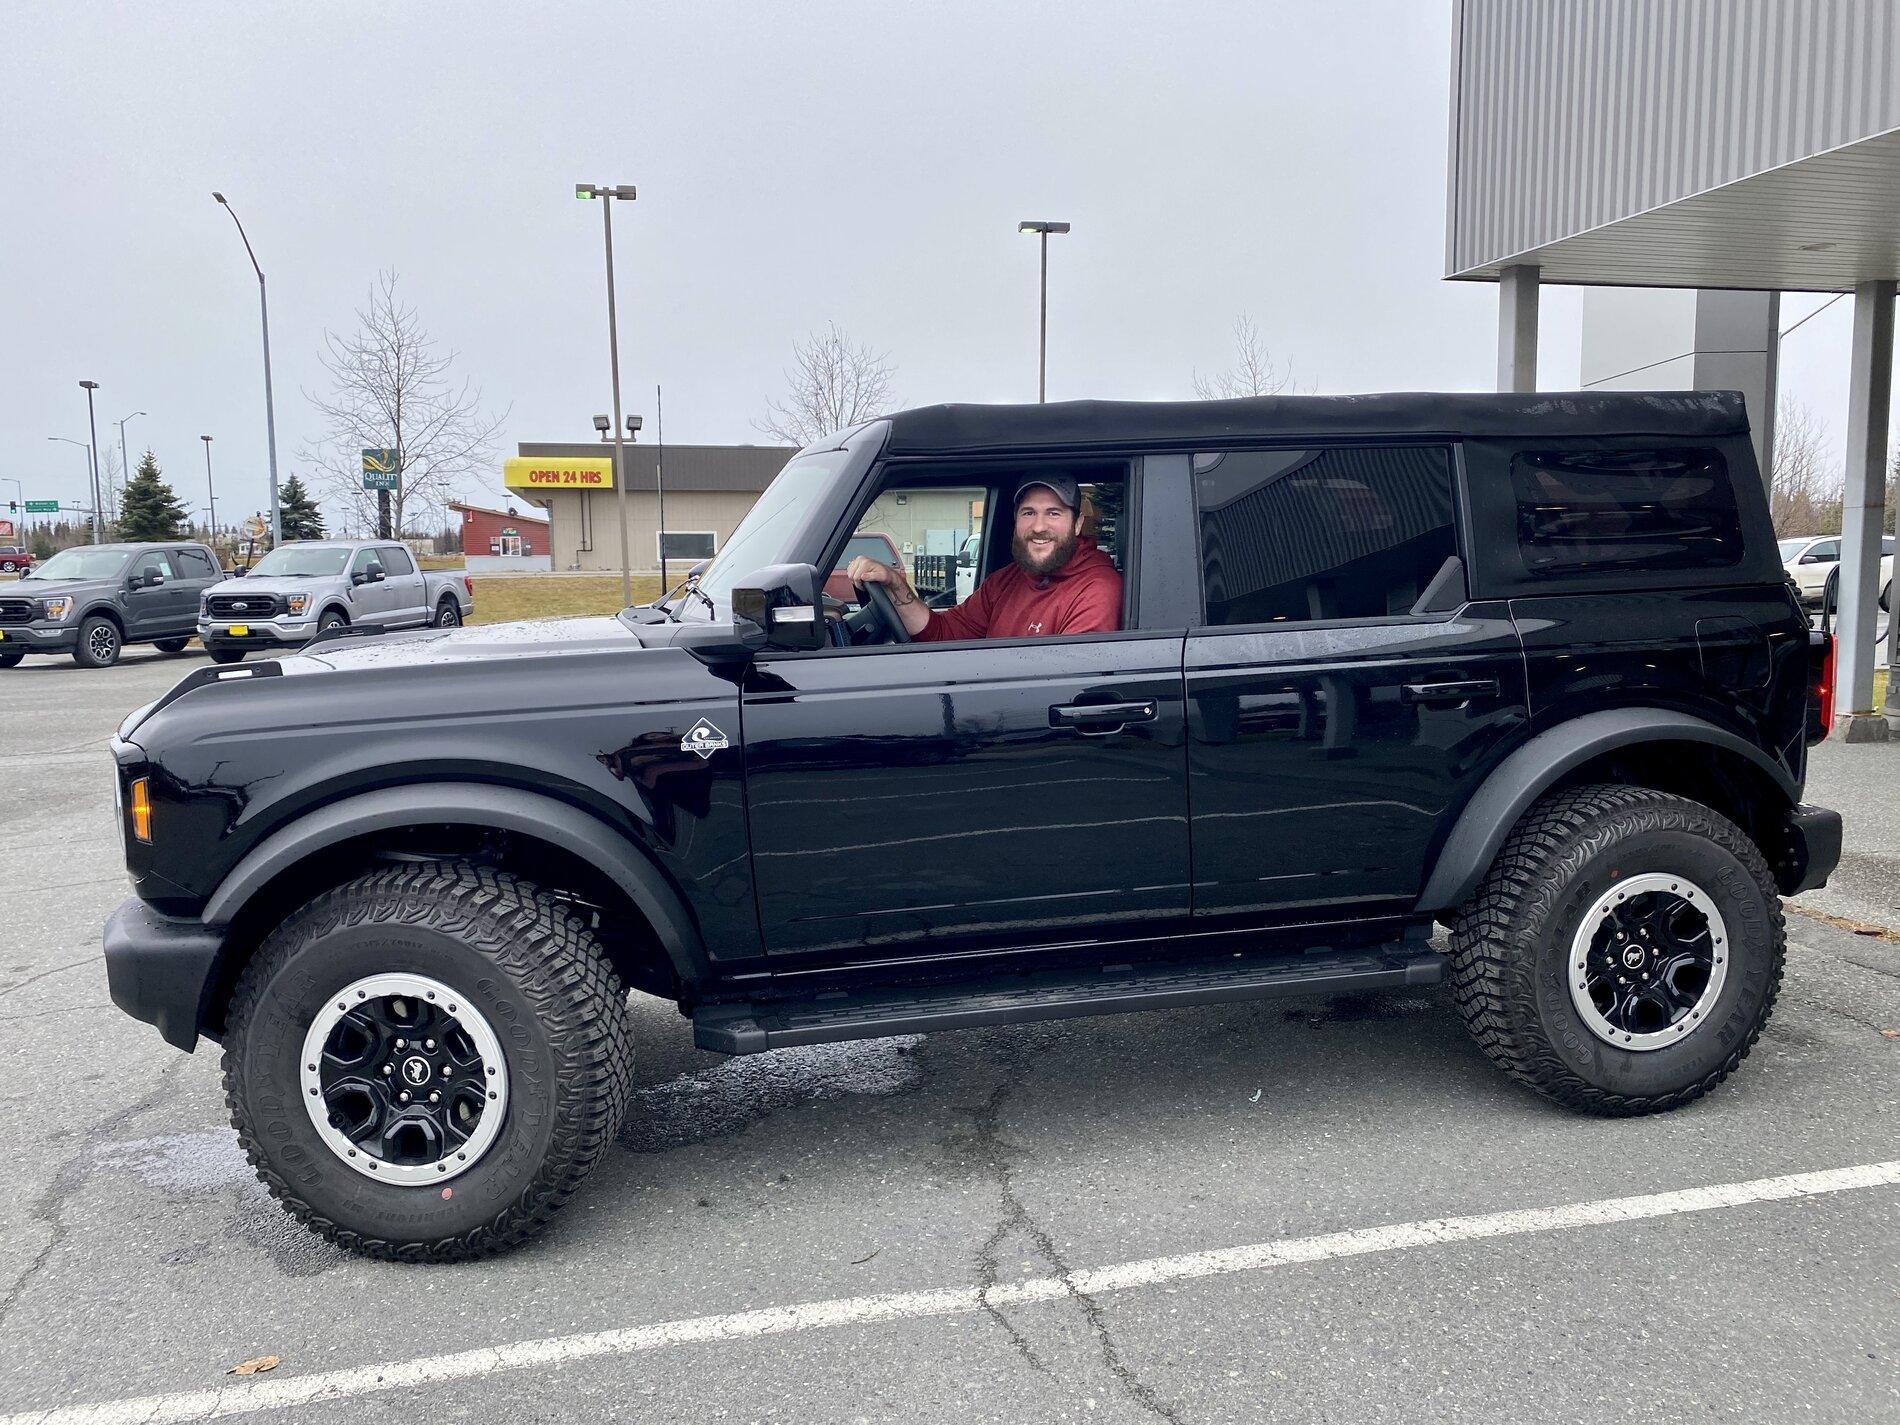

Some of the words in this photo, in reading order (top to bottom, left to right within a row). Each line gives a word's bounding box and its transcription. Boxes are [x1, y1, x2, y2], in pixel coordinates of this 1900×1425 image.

[529, 470, 560, 483] OPEN
[563, 470, 577, 484] 24
[580, 471, 602, 484] HRS
